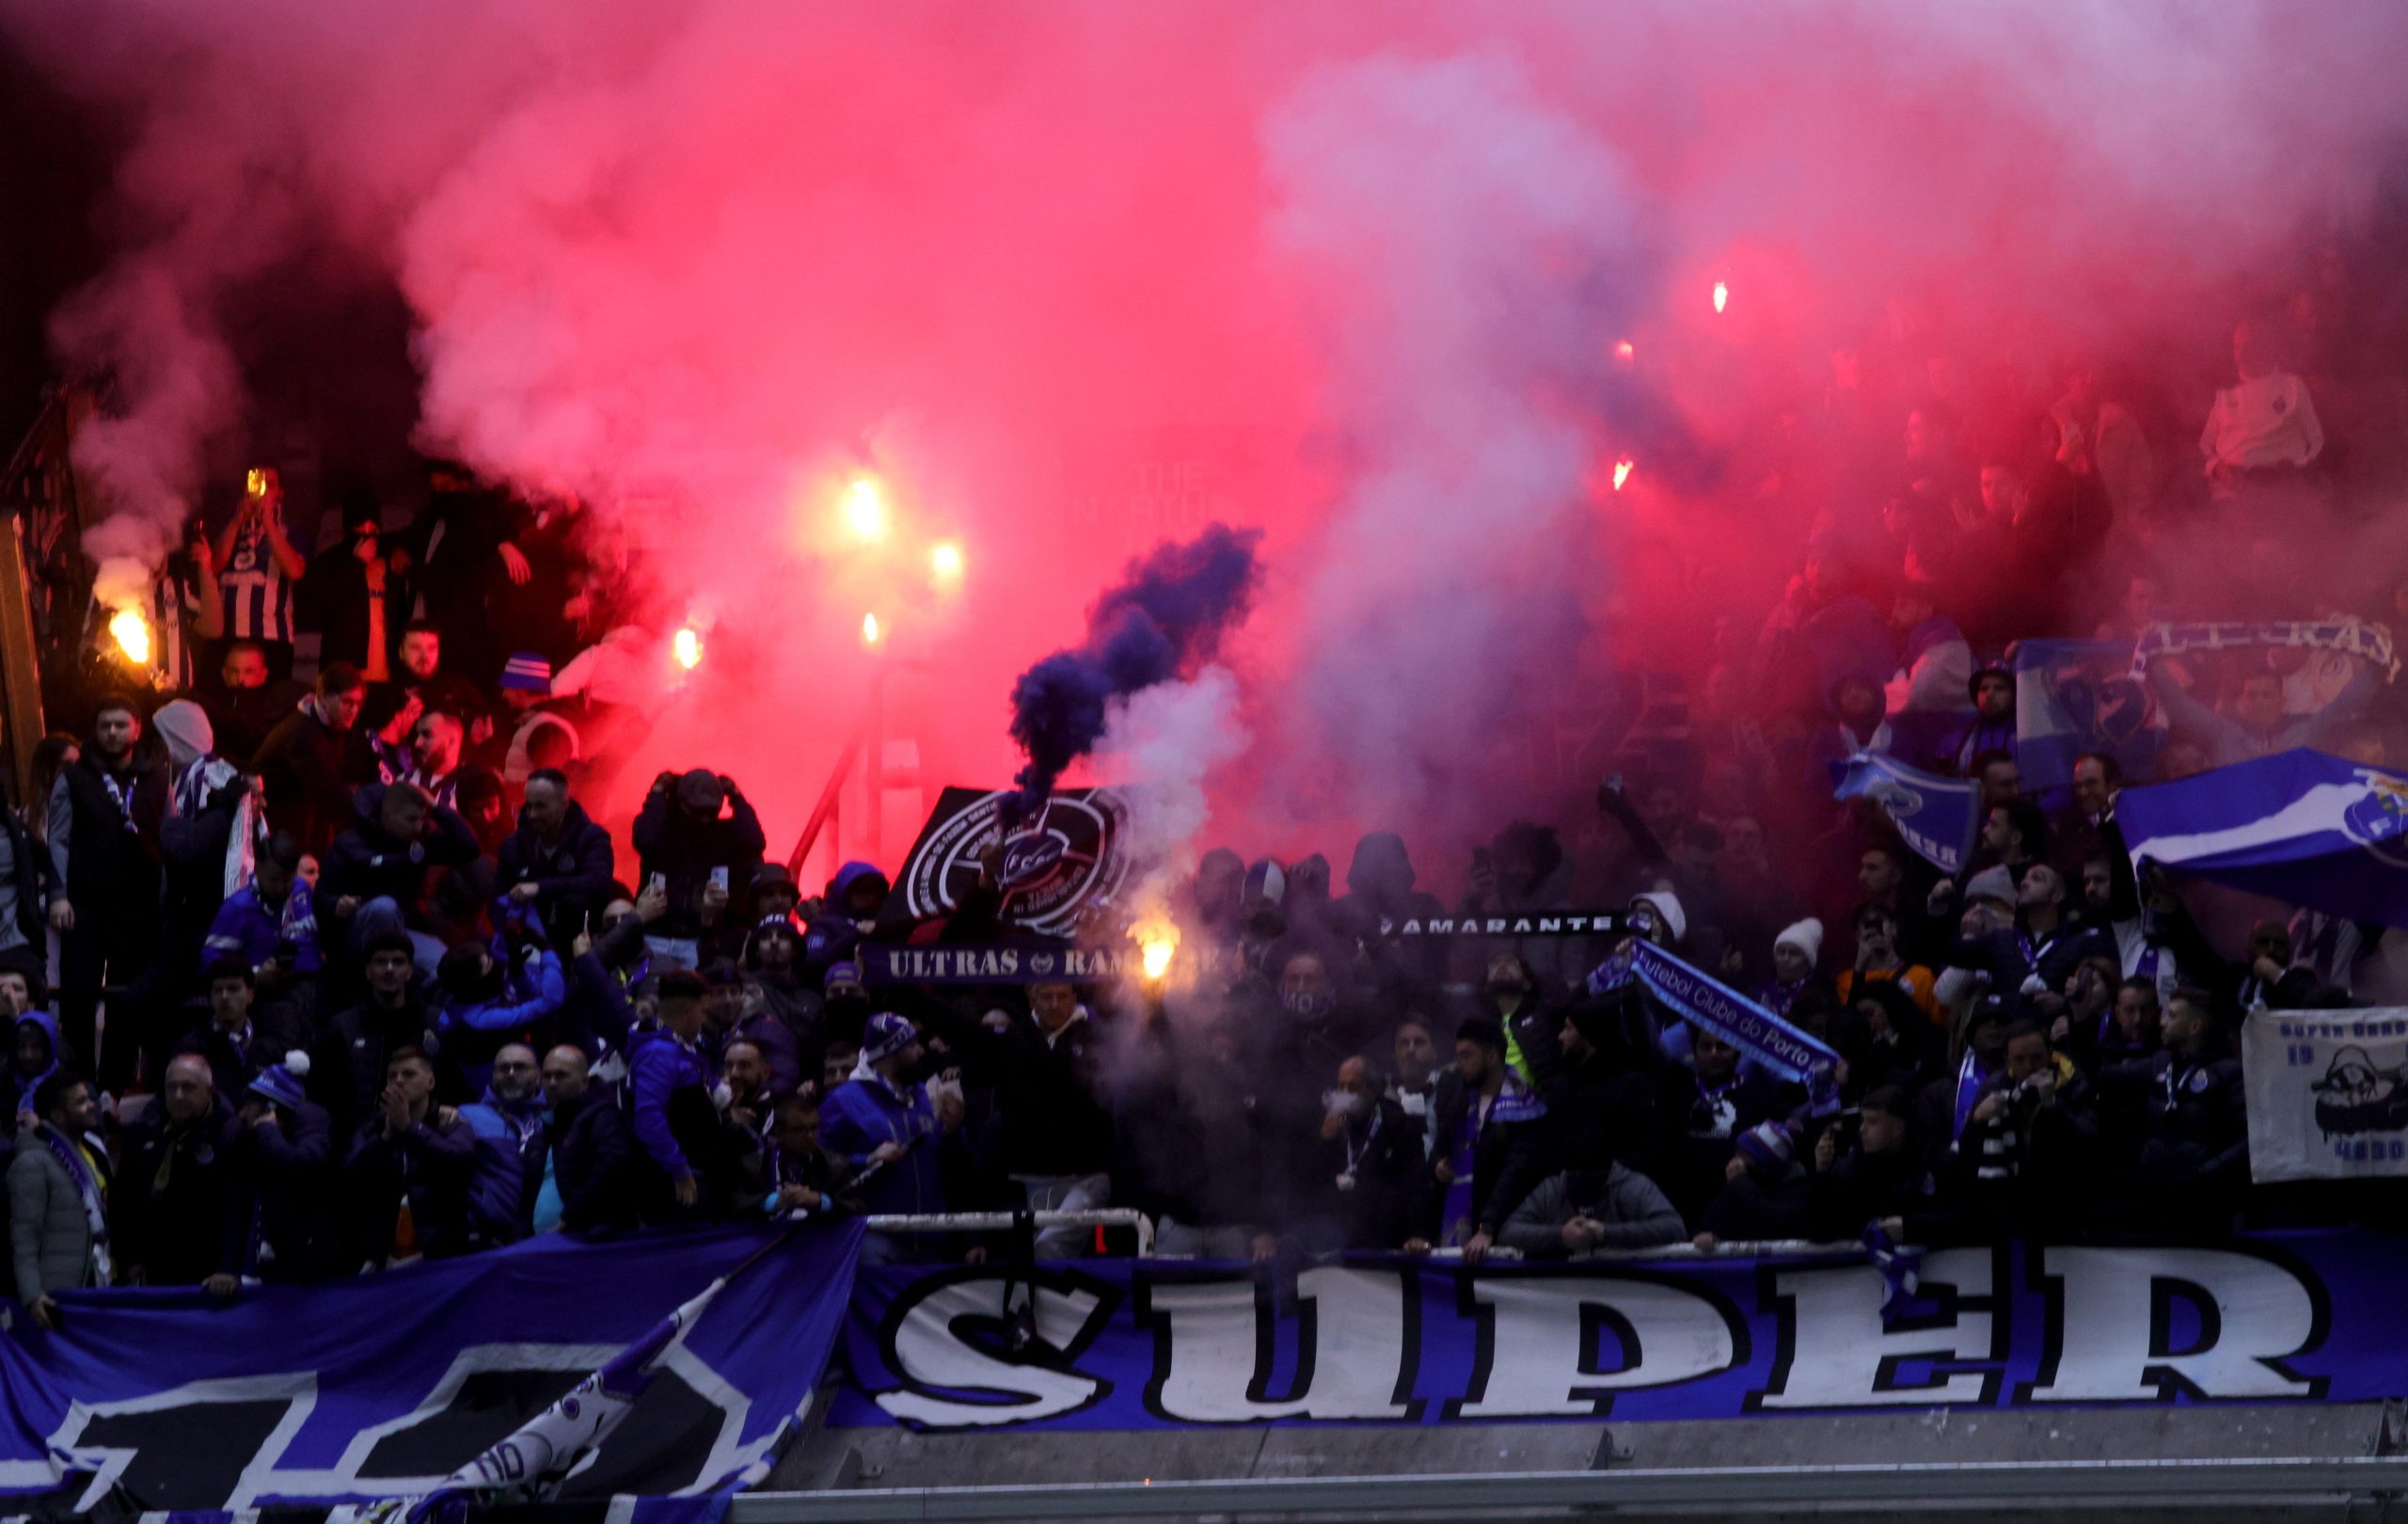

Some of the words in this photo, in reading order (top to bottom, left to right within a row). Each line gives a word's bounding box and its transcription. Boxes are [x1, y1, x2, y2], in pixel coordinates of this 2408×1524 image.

[1402, 916, 1612, 934] AMARANTE
[889, 950, 1019, 977] ULTRAS
[1693, 985, 1738, 1025] Clube
[1739, 1015, 1762, 1039] do
[1762, 1029, 1811, 1067] Porto
[875, 1246, 2313, 1426] SUPER
